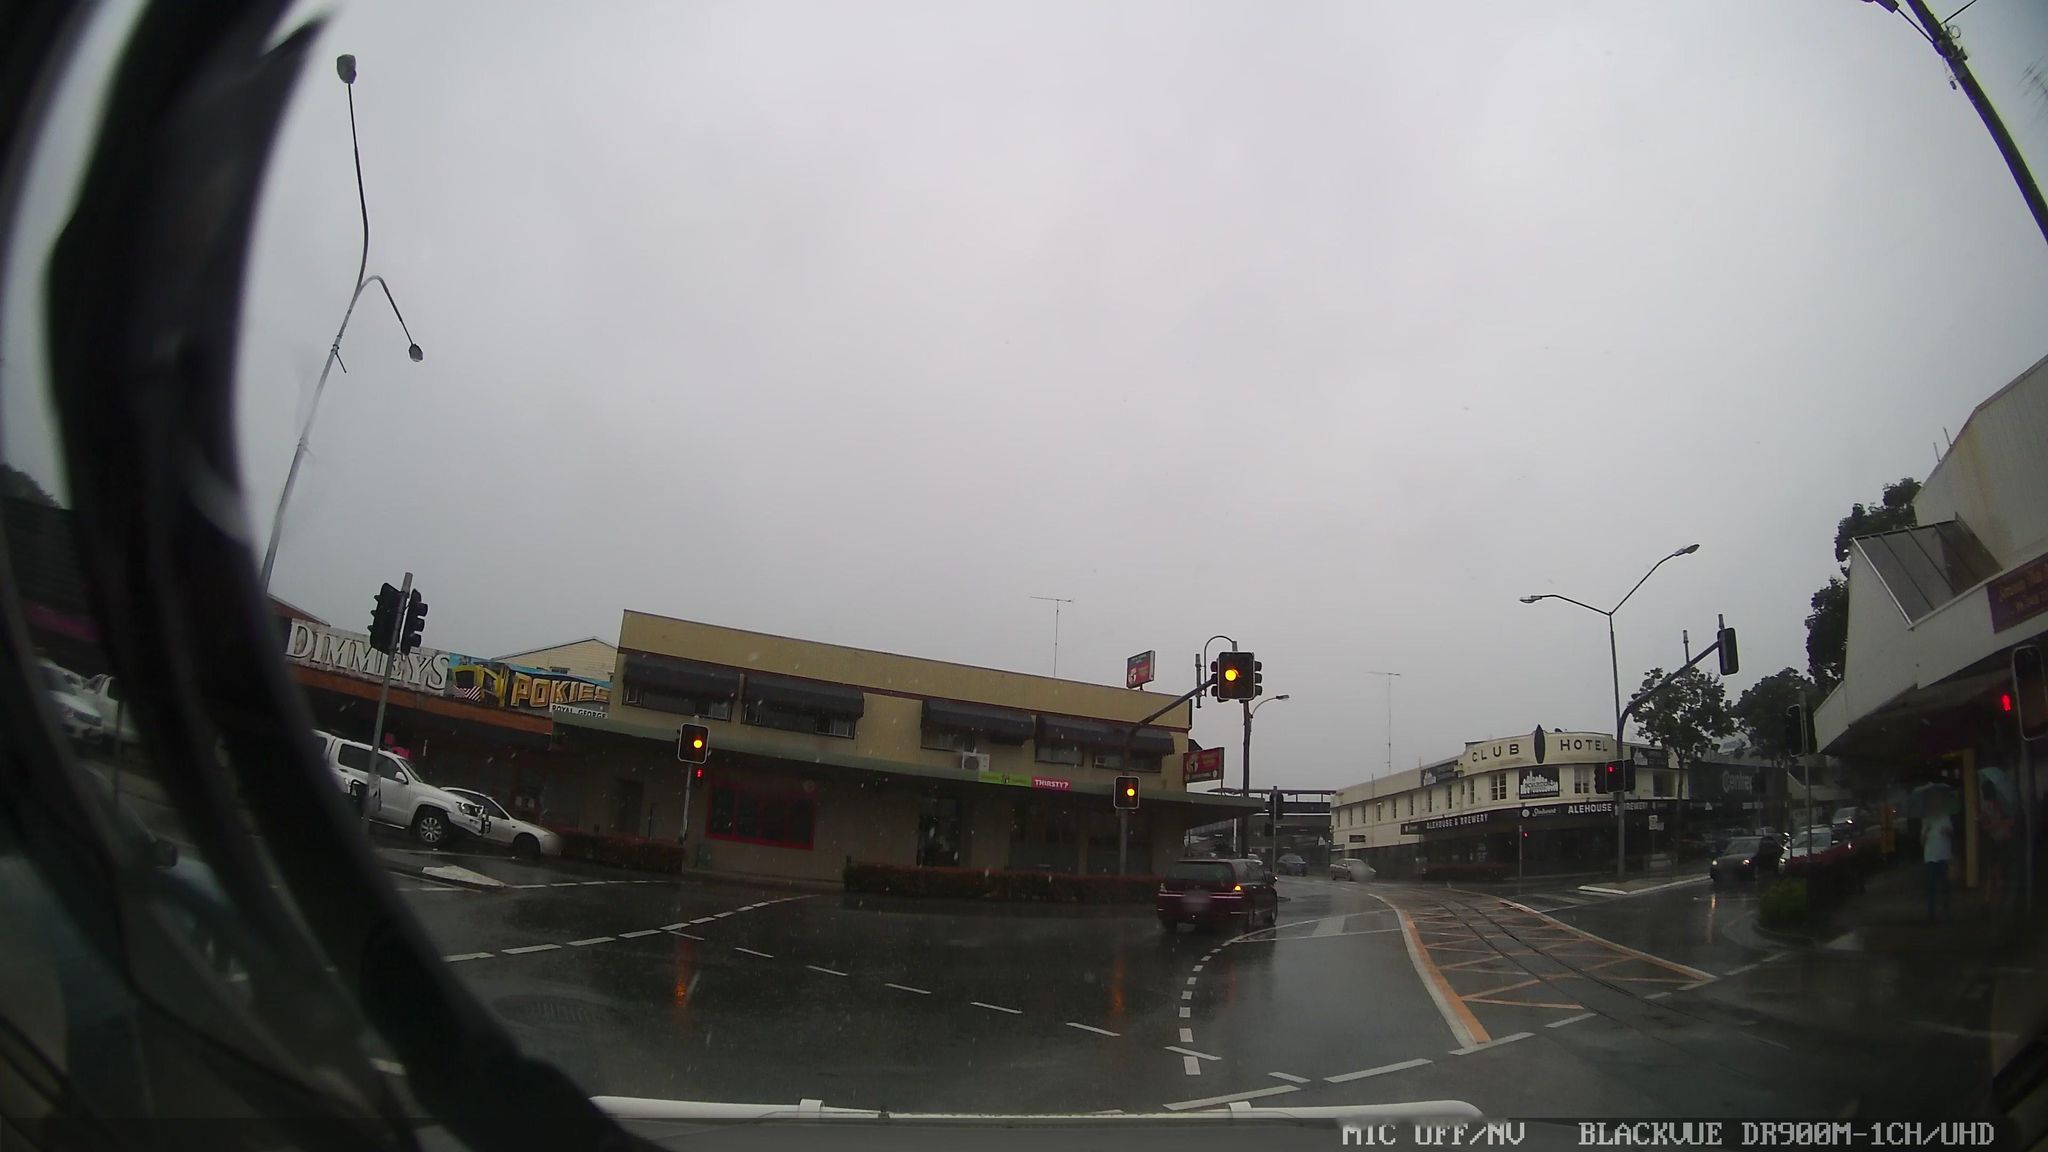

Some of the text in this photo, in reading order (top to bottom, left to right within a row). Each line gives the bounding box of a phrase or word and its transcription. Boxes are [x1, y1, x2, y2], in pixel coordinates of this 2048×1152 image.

[286, 618, 449, 690] DIMMEYS
[510, 672, 610, 708] POKIES
[1471, 739, 1608, 763] CLUB HOTEL
[1034, 779, 1069, 788] THIRSTY?
[1568, 803, 1612, 814] ALEHOUSE
[1426, 818, 1453, 829] ALEHOUSE
[1460, 813, 1488, 825] BREWERY
